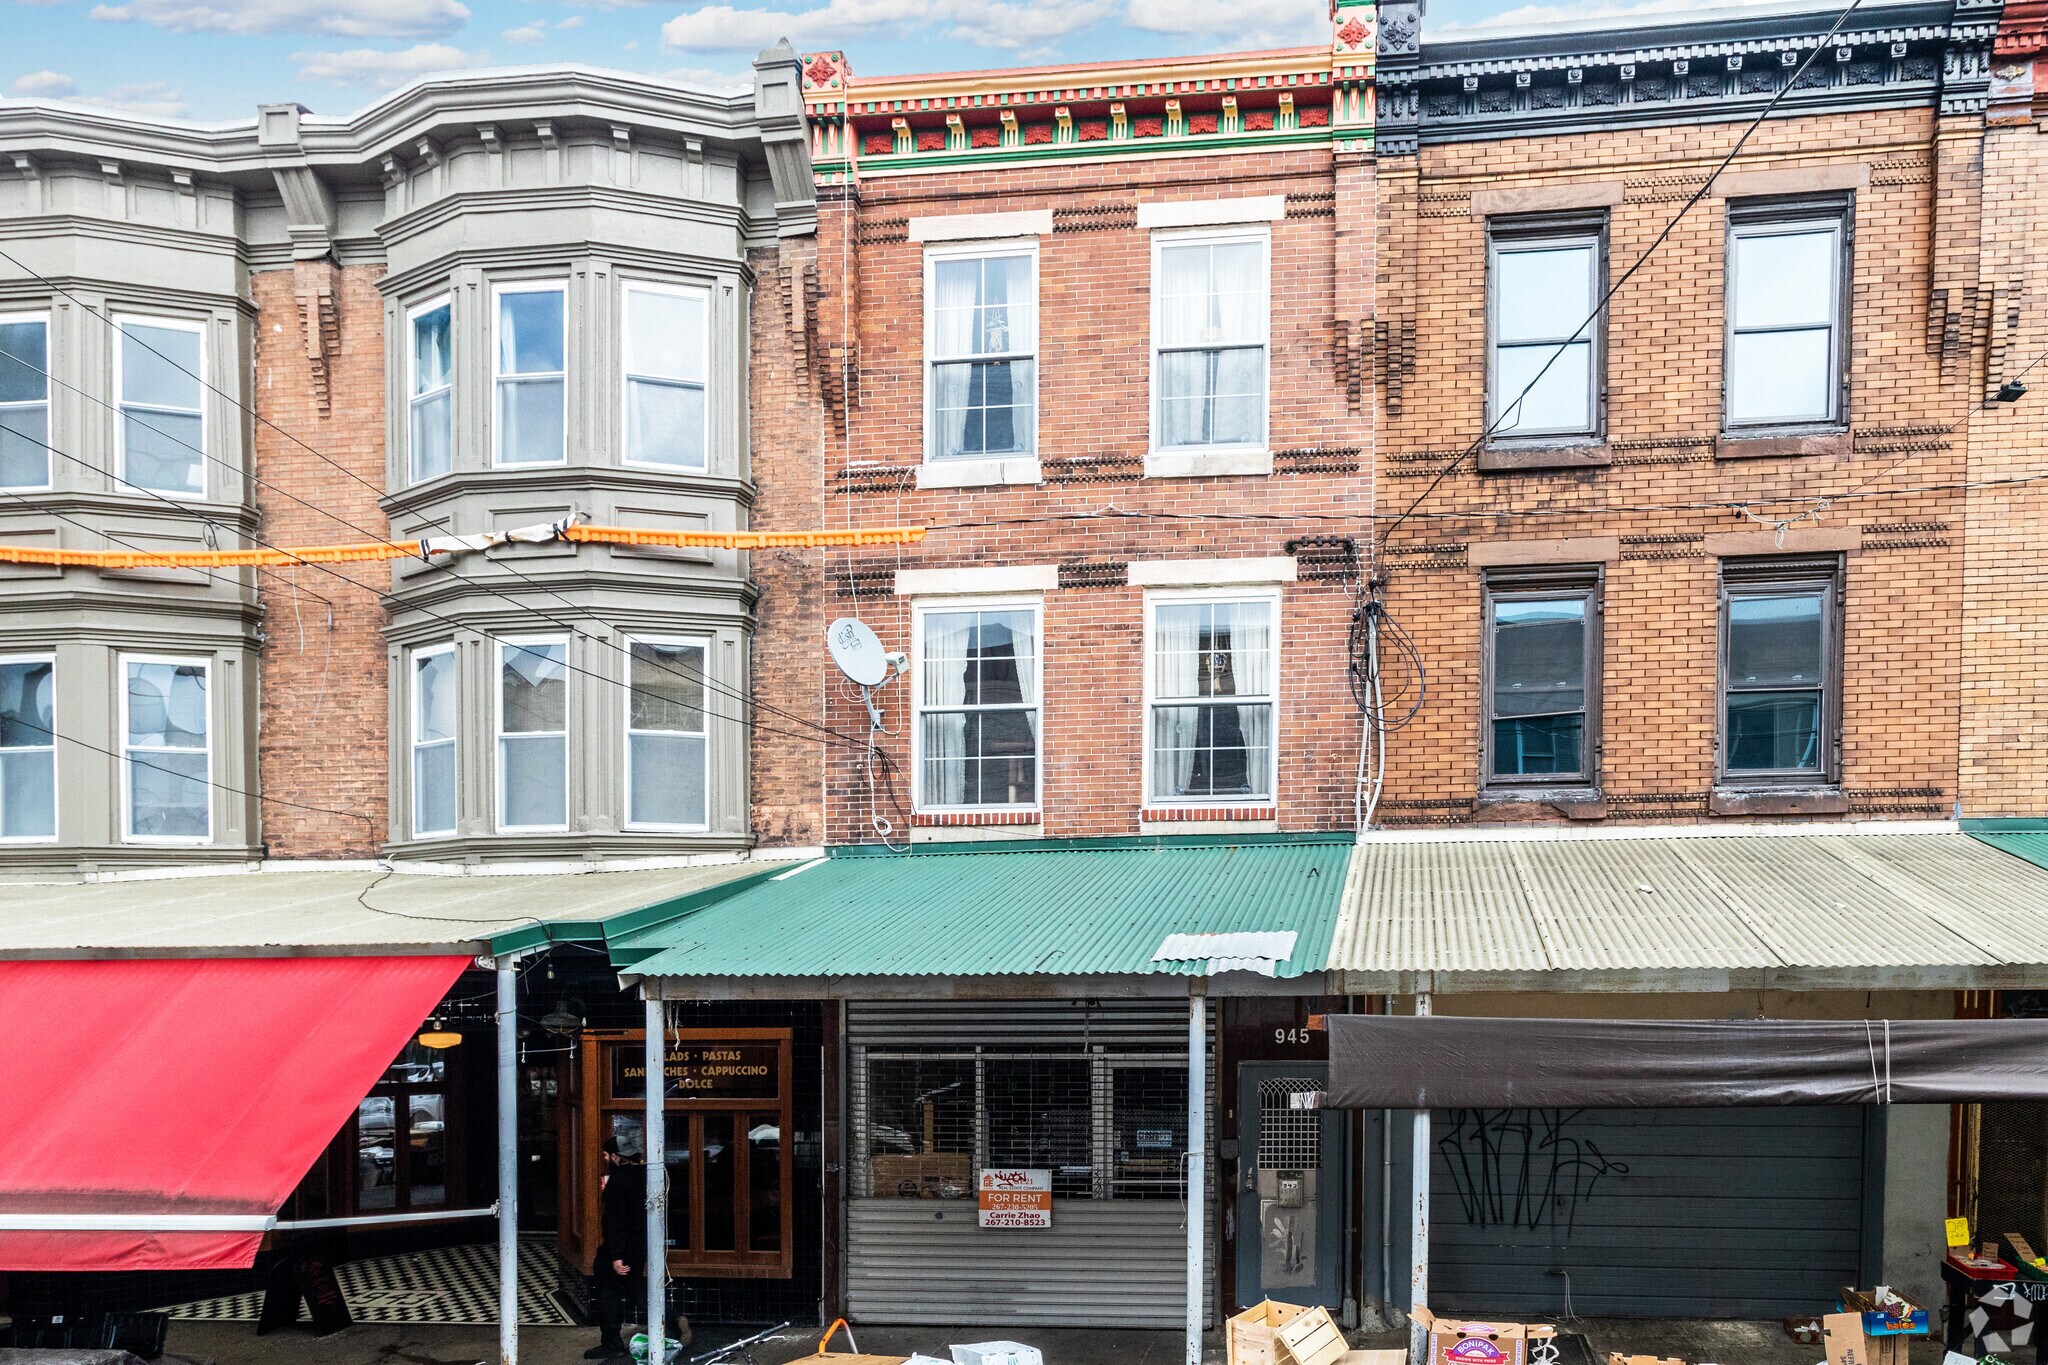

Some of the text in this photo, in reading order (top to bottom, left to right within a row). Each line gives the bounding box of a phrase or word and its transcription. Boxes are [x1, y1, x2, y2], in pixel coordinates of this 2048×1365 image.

[1275, 1028, 1310, 1044] 945
[663, 1051, 741, 1061] LADS PASTAS
[624, 1065, 768, 1077] SANCHES CAPPUCCINO
[679, 1079, 713, 1089] DOLCE
[988, 1193, 1042, 1202] FOR RENT
[1886, 1321, 1915, 1330] halos
[1457, 1341, 1495, 1355] BONIPAK
